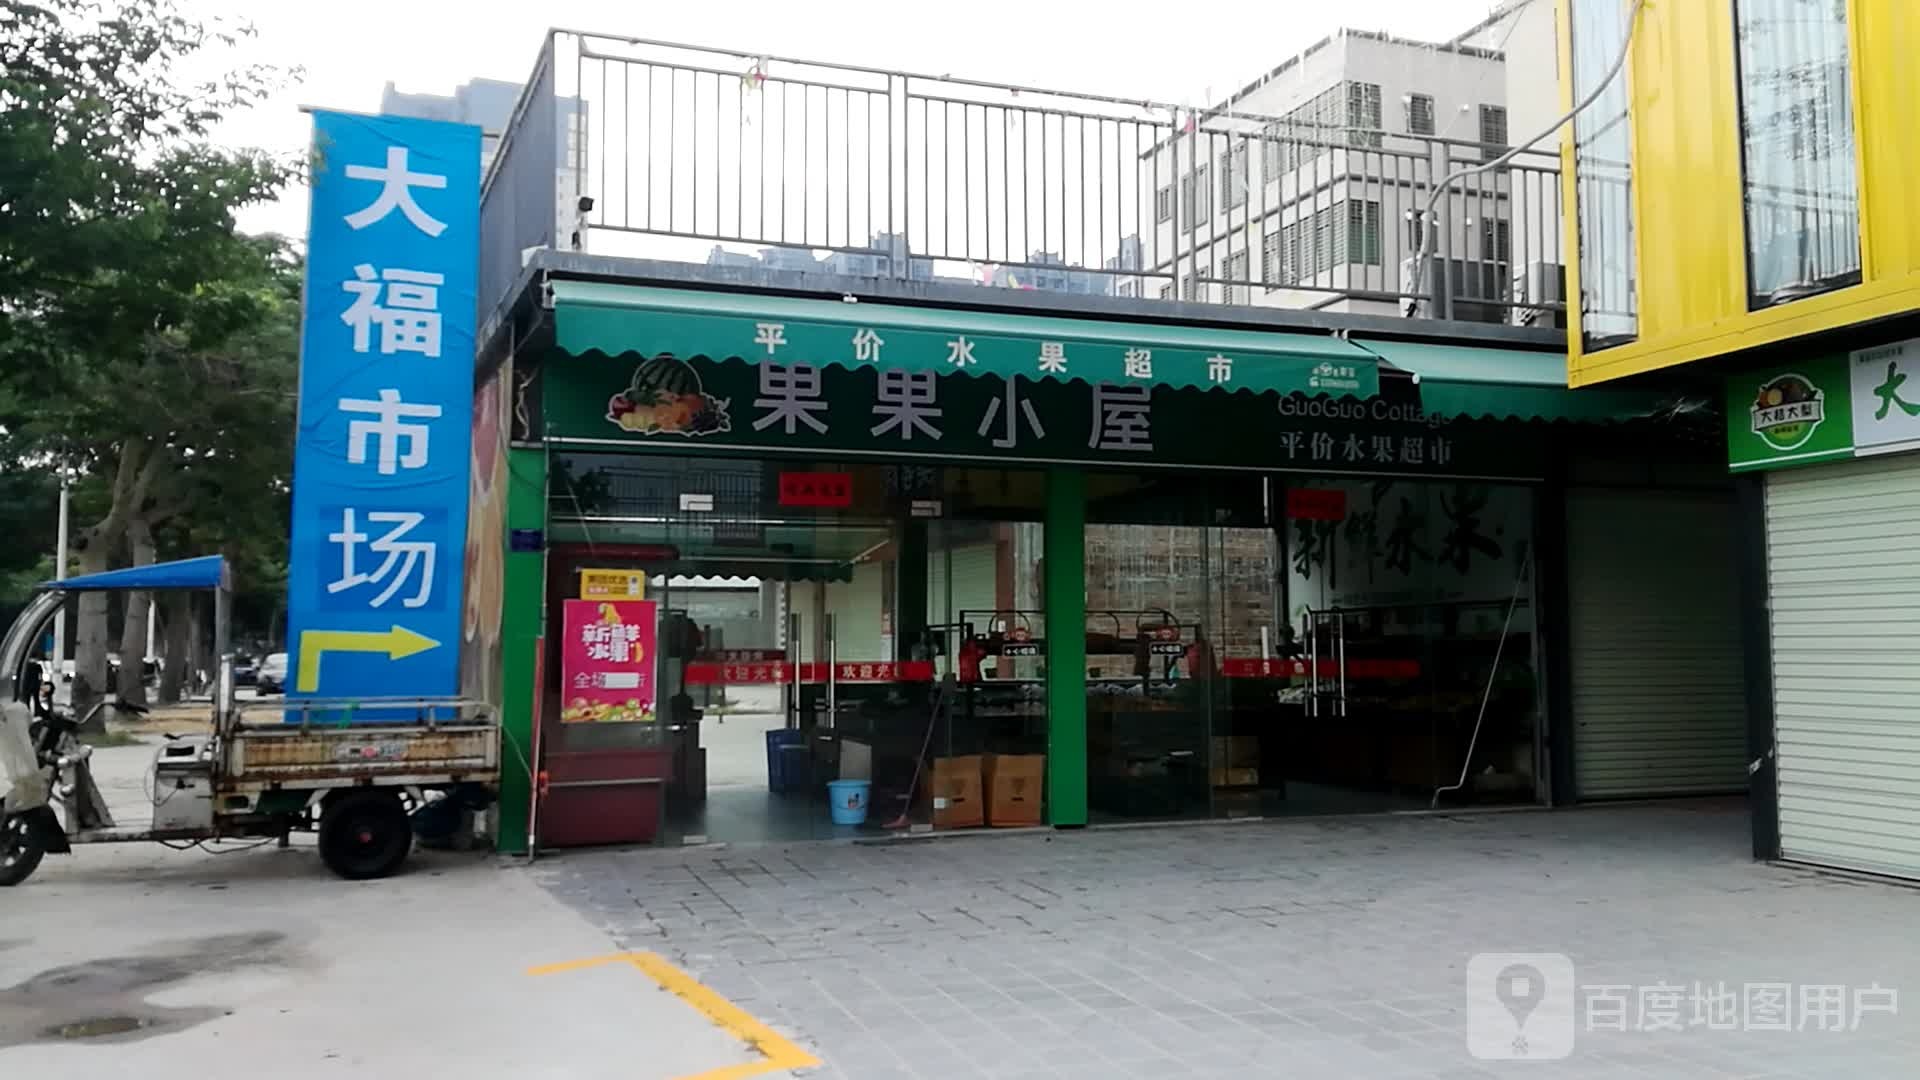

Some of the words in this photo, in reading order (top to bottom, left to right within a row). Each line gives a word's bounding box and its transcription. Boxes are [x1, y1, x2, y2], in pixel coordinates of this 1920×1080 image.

[327, 146, 449, 609] 大福市场
[754, 321, 1233, 385] 平价水果超市
[751, 360, 1153, 453] 果果小屋
[1278, 396, 1367, 420] GuoGuo
[1279, 430, 1454, 466] 平价水果超市
